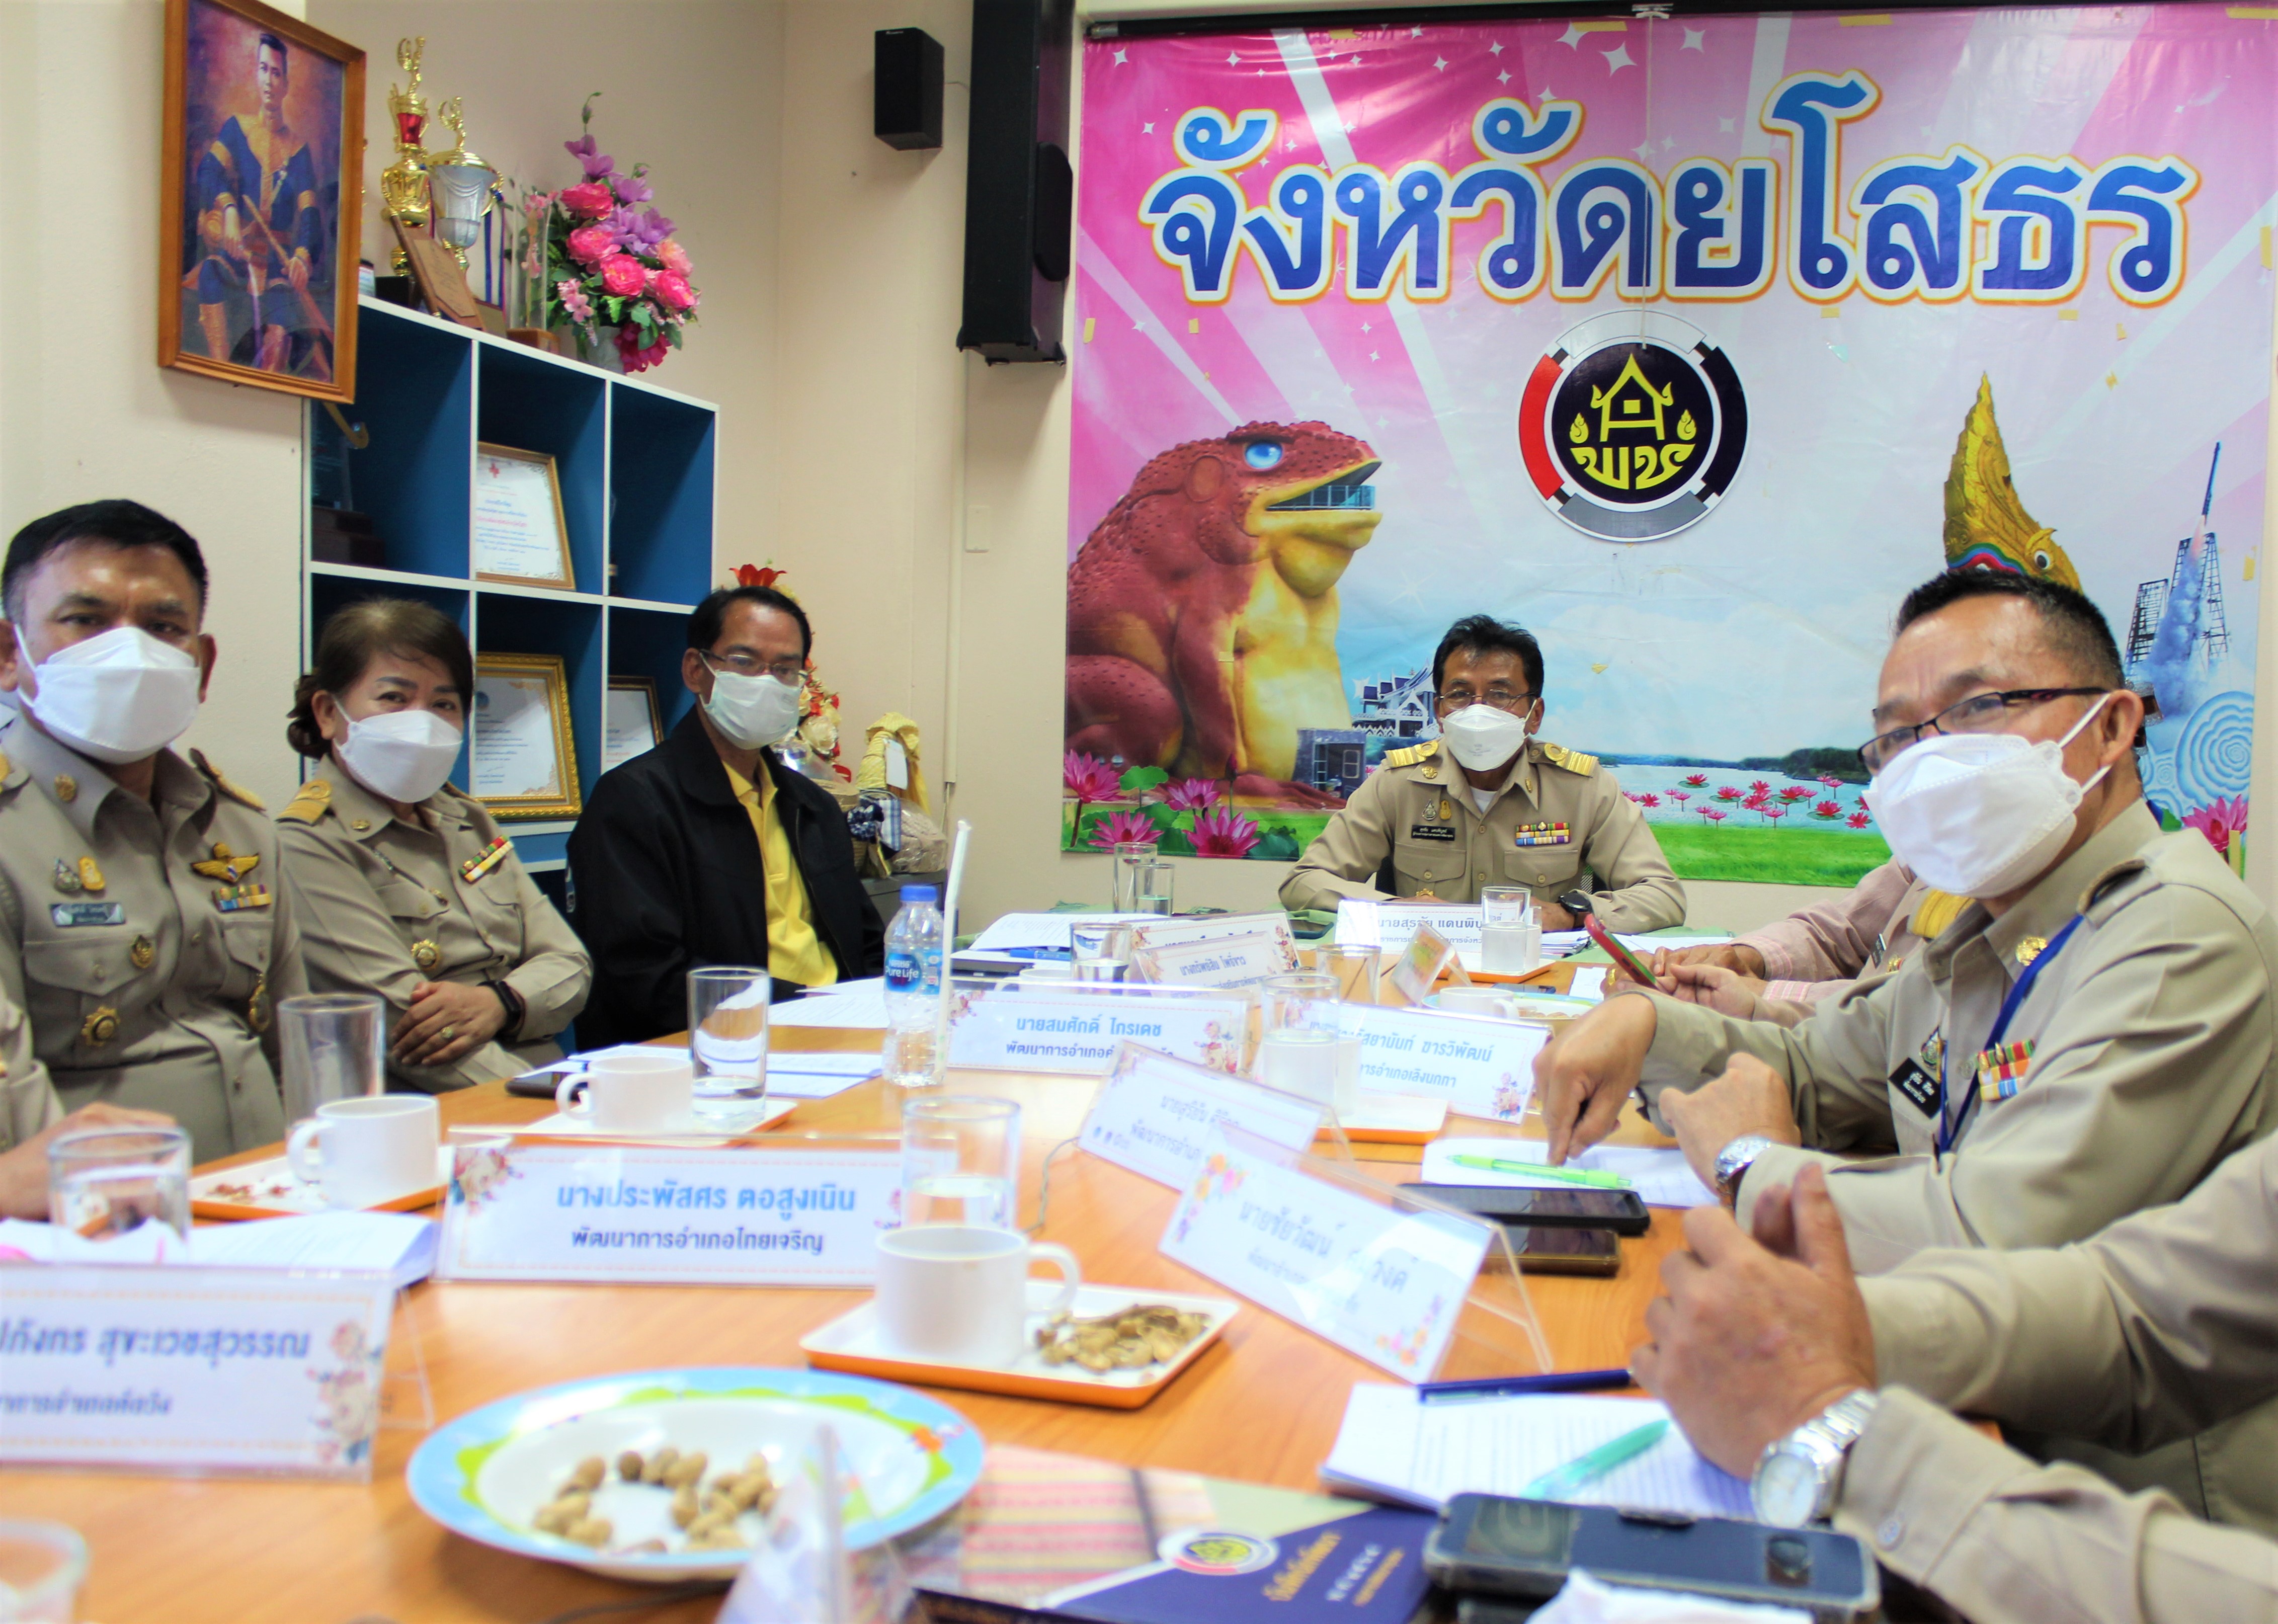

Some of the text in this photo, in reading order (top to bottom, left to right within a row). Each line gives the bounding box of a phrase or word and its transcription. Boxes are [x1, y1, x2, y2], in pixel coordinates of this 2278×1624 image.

[1145, 73, 2189, 302] จังหวัดยโสธร
[903, 968, 919, 982] Life
[1016, 1014, 1162, 1037] นายสมศักดิ์ ไกรเดช
[557, 1179, 855, 1221] นางประพัสศร ตอสูงเนิน
[572, 1225, 824, 1256] พัฒนาการอำเภอไทยเจริญ
